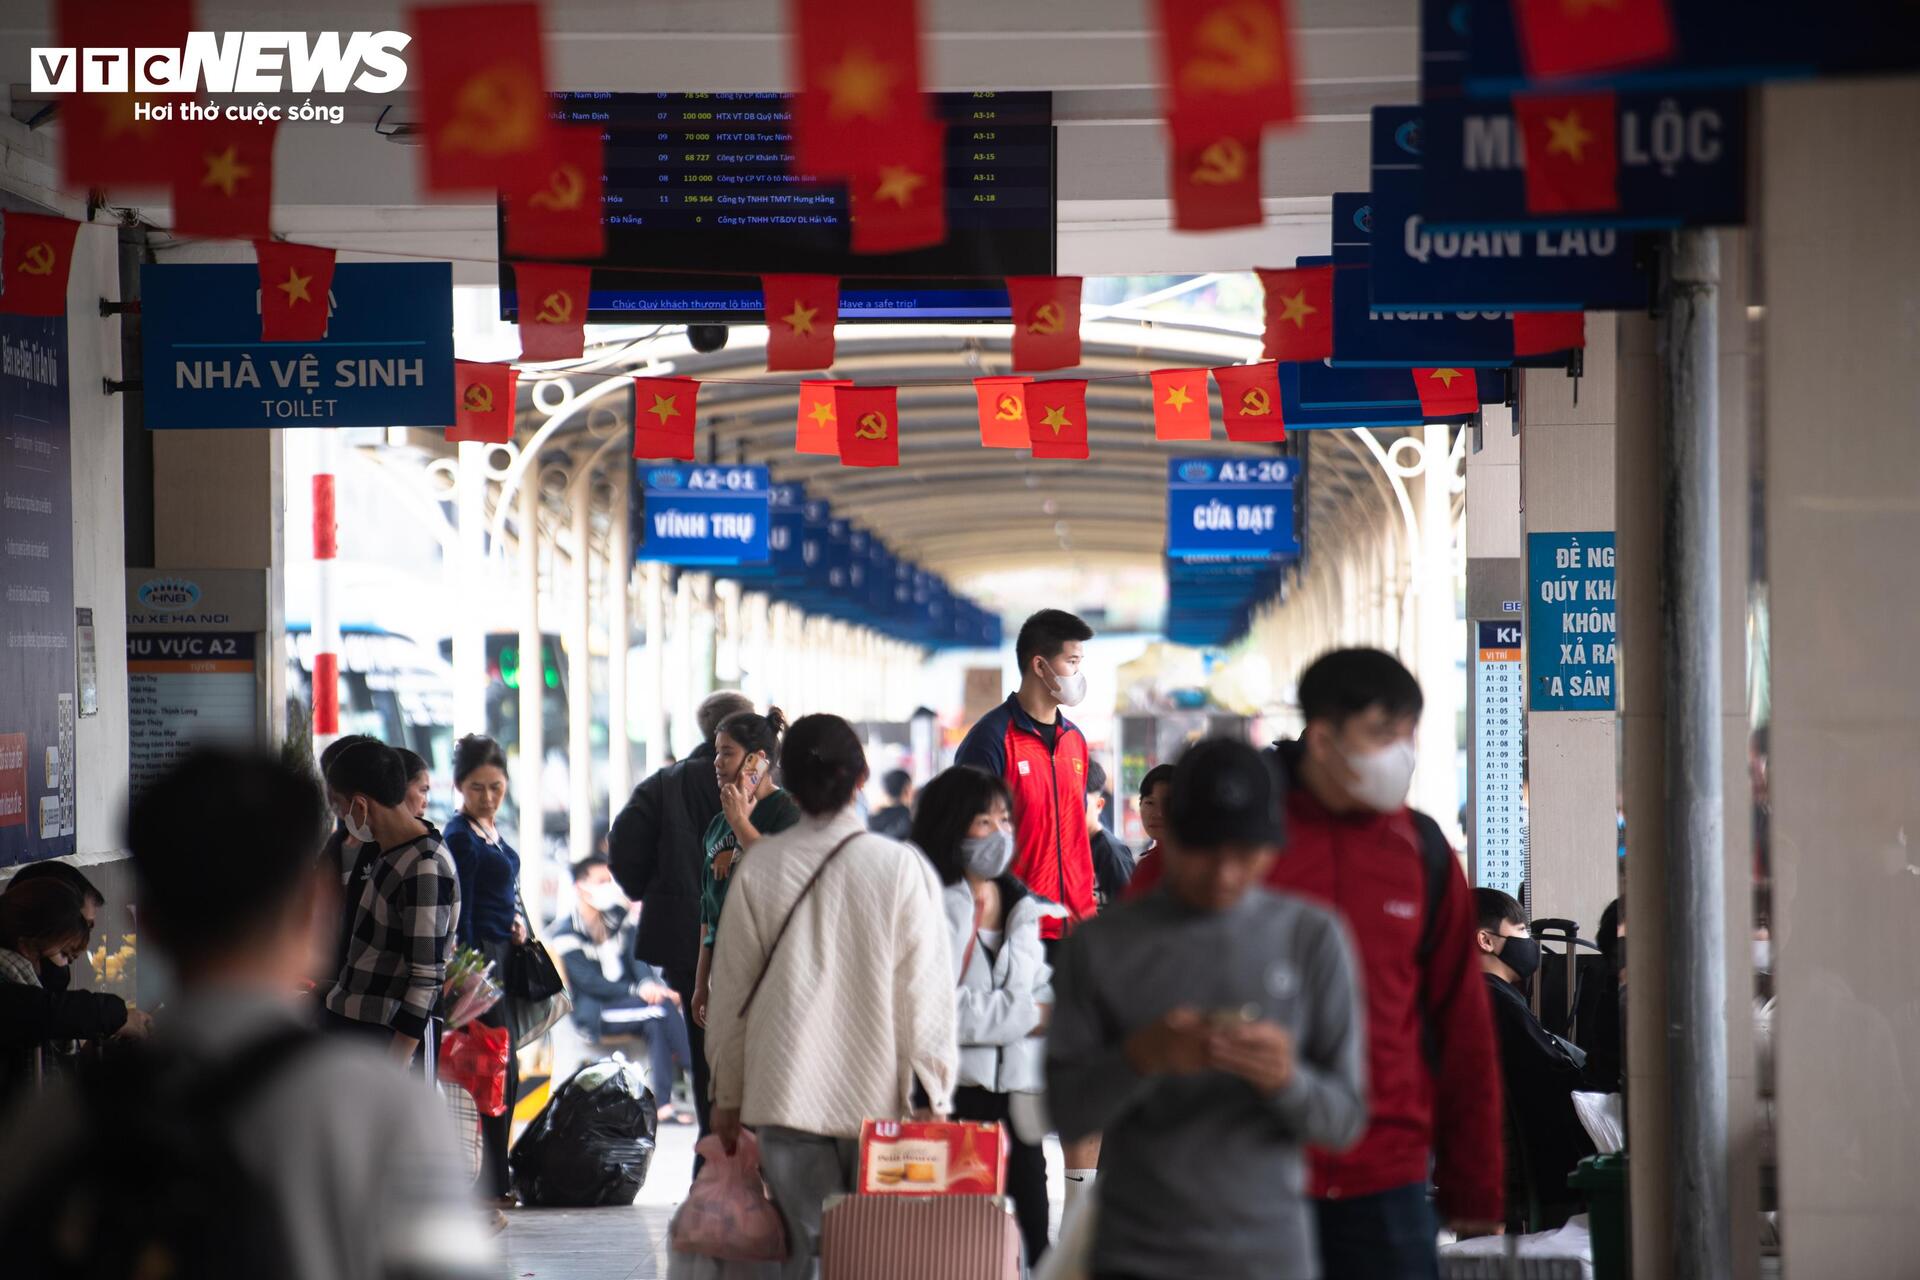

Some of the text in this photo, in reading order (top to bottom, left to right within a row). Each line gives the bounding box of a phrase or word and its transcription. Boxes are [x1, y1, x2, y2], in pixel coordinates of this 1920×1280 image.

[658, 112, 667, 120] 07
[1622, 97, 1724, 177] LỘC
[612, 299, 636, 308] Chúc
[660, 299, 688, 308] khách
[840, 299, 863, 308] Have
[874, 299, 894, 308] safe
[896, 299, 916, 309] trip!
[175, 353, 424, 395] NHÀ VỆ SINH
[261, 399, 338, 417] TOILET
[687, 469, 755, 490] A2-01
[1218, 461, 1288, 483] A1-20
[654, 508, 707, 539] VĨNH
[709, 512, 756, 544] TRỤ
[1192, 497, 1276, 535] CỬA ĐẠT
[1556, 536, 1615, 569] ĐỀ NG
[1502, 601, 1521, 612] BE
[148, 615, 168, 623] XE
[1562, 606, 1616, 633] KHÔN
[1496, 628, 1521, 643] KH
[127, 637, 237, 658] HU VỰC A2
[1560, 636, 1616, 665] XẢ RÁ
[1546, 669, 1610, 697] A SÂN
